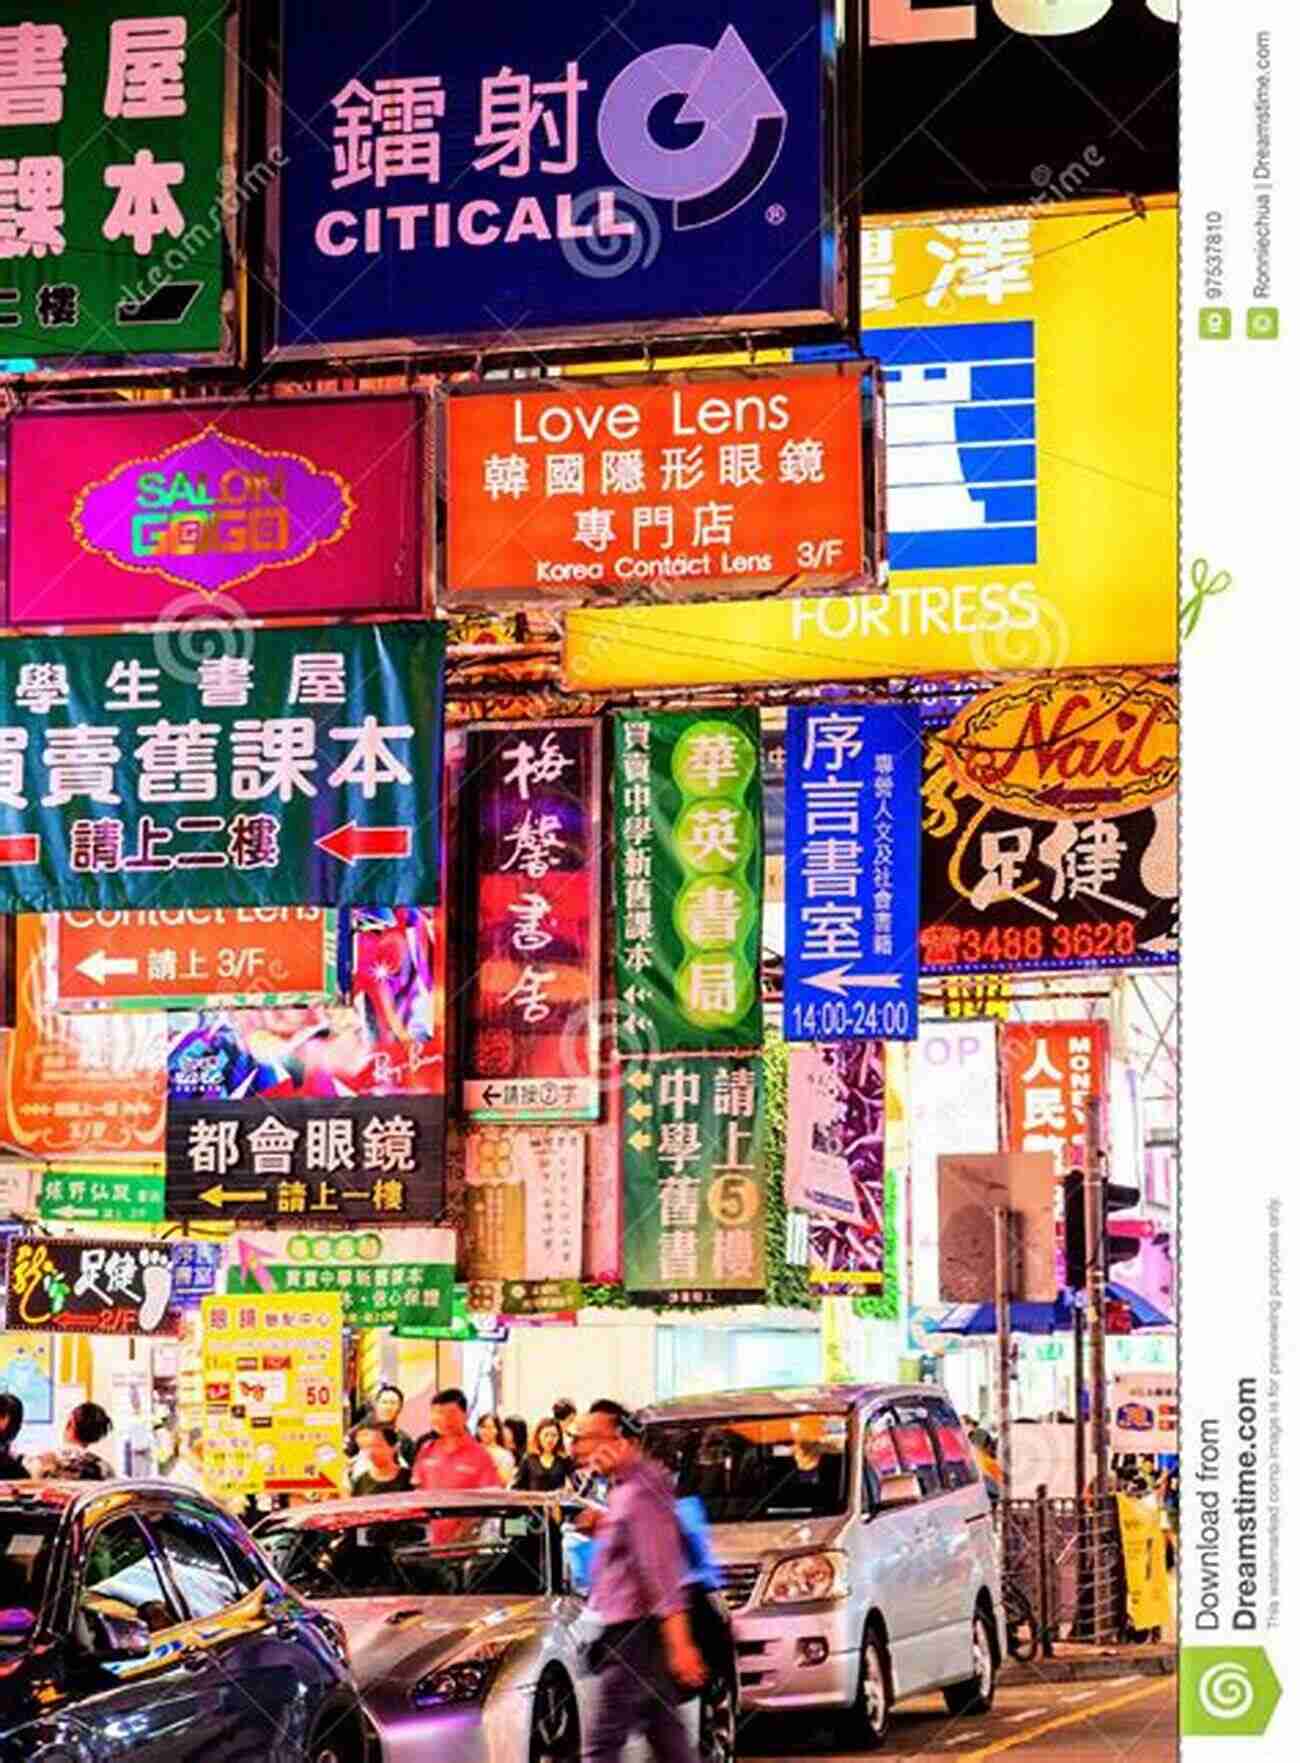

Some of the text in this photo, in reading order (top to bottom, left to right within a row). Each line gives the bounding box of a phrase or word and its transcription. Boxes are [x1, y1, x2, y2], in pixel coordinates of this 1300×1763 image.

[330, 61, 588, 191] 鐳射
[315, 191, 637, 257] CITICALL
[514, 391, 789, 444] Love Lens
[483, 438, 825, 500] 韓國隱形眼鏡
[572, 501, 735, 551] 專門店
[797, 540, 845, 569] 3/F
[536, 551, 774, 582] Korea Contact Lens
[790, 583, 1041, 642] FORTRESS
[16, 652, 347, 714] 學生書屋
[965, 694, 1172, 785] Nail
[70, 814, 280, 874] 請上二樓
[801, 712, 864, 961] 序言書室
[686, 731, 742, 1015] 華英書局
[217, 946, 266, 978] 3/F
[963, 928, 1043, 963] 3488
[793, 1000, 910, 1037] 14:00-24:00
[188, 1115, 416, 1174] 都會眼鏡
[658, 1067, 702, 1280] 中學舊書
[277, 1178, 404, 1213] 請上一樓
[306, 1385, 331, 1406] 50
